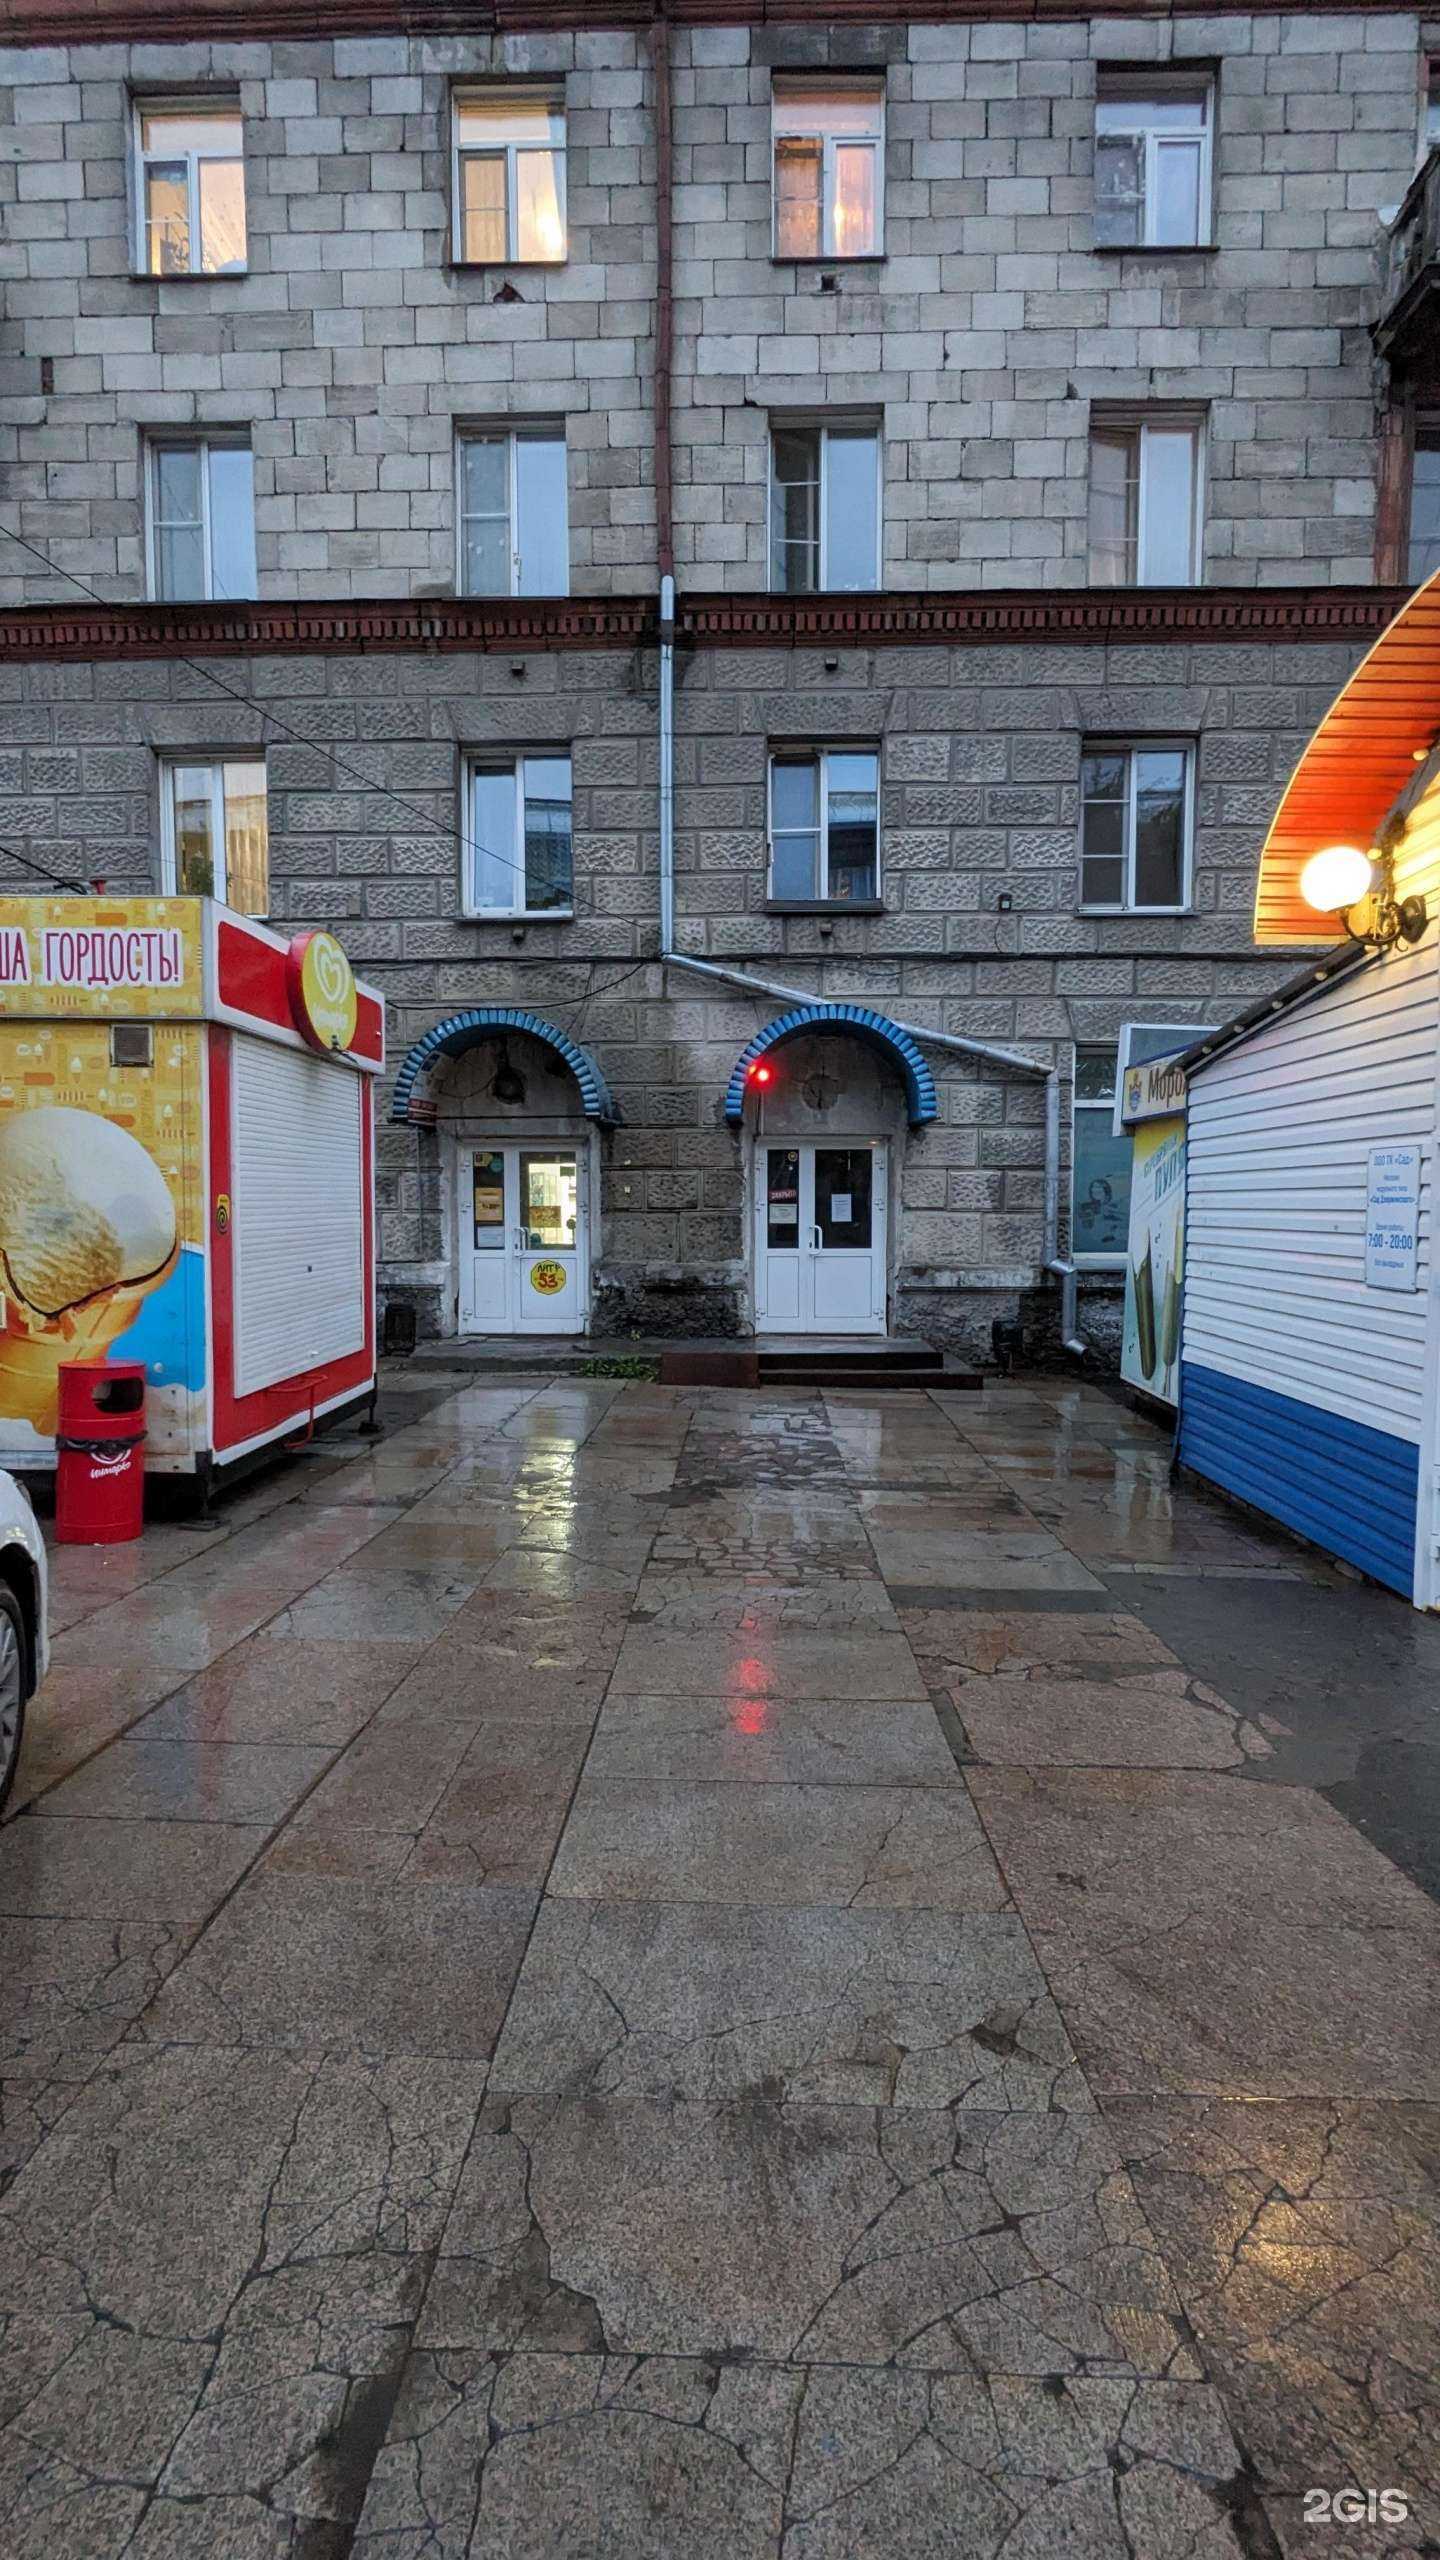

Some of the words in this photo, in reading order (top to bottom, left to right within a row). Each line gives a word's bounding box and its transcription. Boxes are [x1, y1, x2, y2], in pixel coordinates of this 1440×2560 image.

[46, 932, 179, 985] ГОРДОСТЬ!
[1368, 1232, 1383, 1248] 7:00
[1390, 1234, 1413, 1250] 20:00
